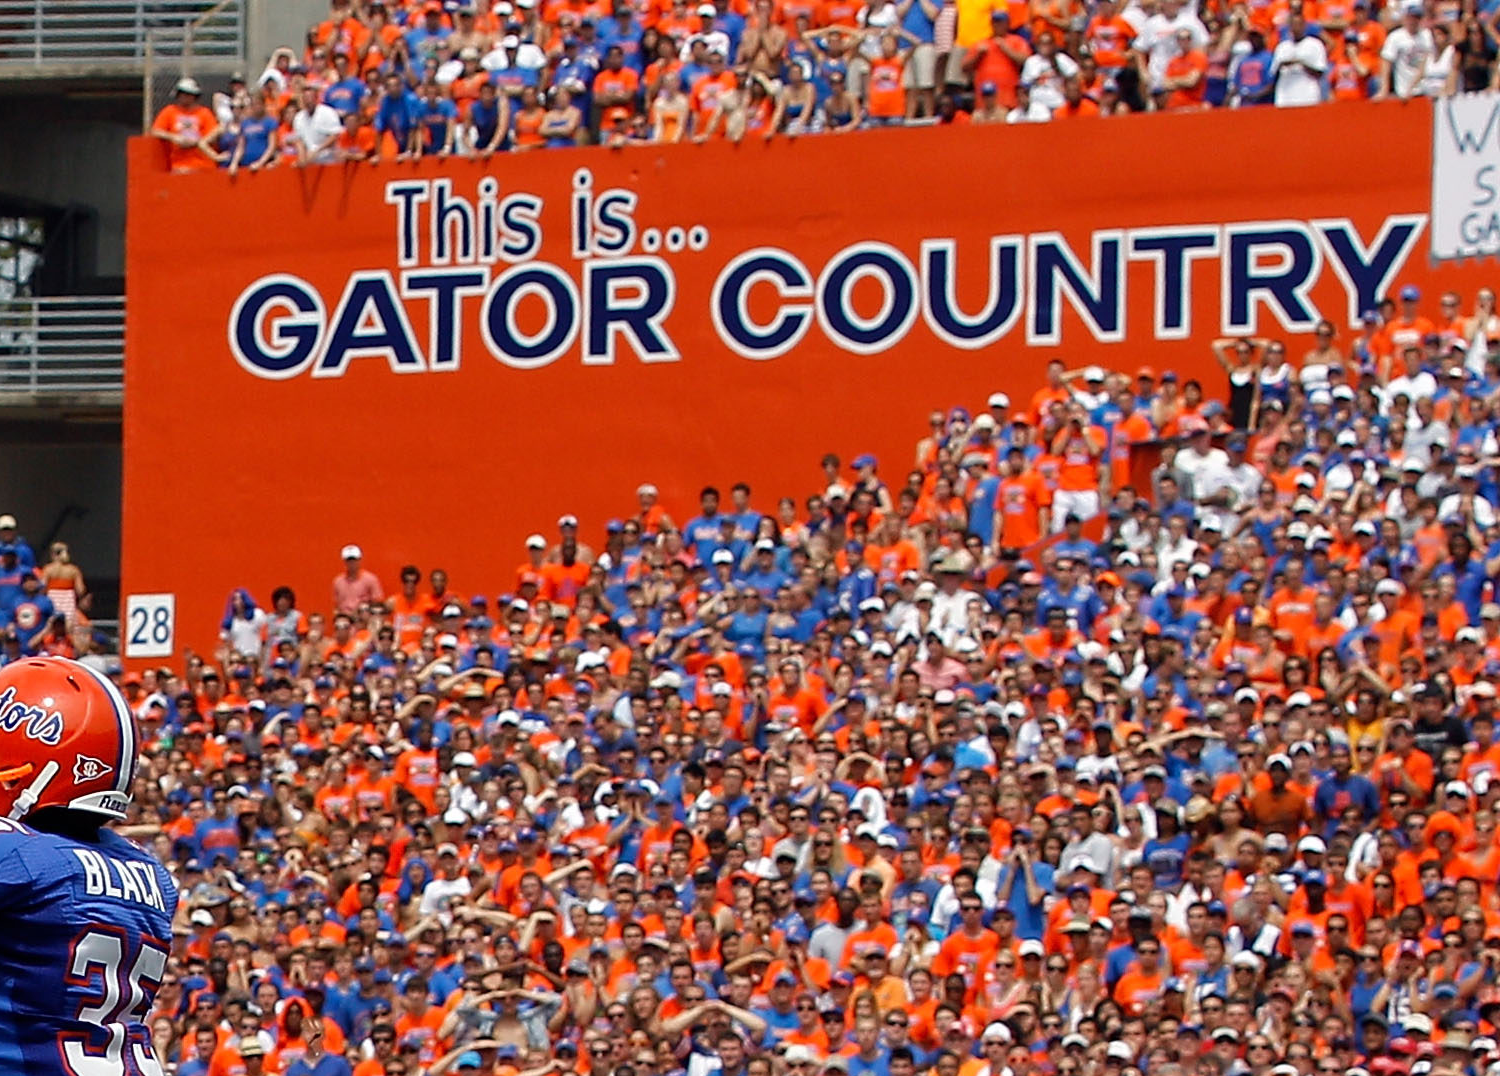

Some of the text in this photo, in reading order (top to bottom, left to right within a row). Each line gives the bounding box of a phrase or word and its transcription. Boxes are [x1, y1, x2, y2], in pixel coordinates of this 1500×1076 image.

[386, 167, 709, 268] This is...
[228, 212, 1429, 380] GATOR COUNTRY
[129, 605, 170, 646] 28
[73, 848, 166, 912] BLACK
